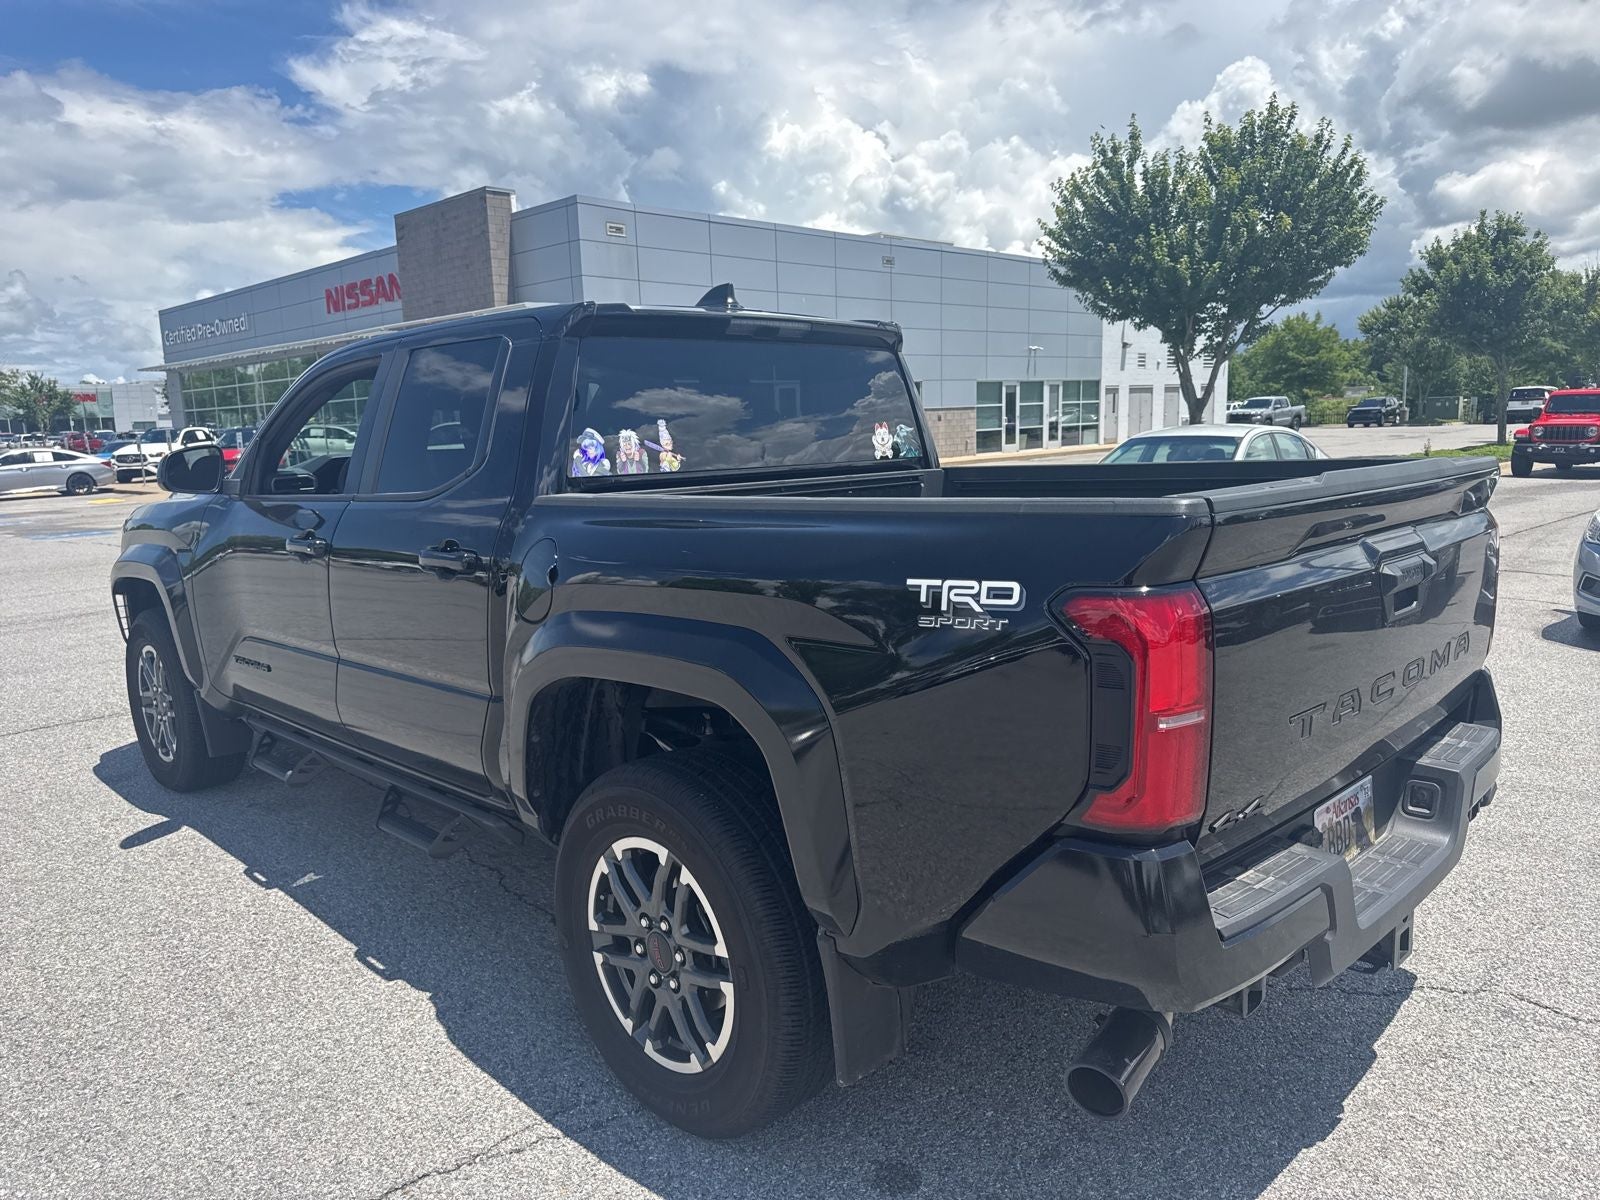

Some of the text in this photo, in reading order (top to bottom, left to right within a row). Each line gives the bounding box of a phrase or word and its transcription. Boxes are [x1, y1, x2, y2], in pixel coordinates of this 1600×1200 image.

[325, 272, 402, 314] NISSAN
[164, 326, 196, 346] Certified
[906, 578, 1022, 613] TRD
[918, 615, 1009, 631] SPORT
[1288, 630, 1471, 741] TACOMA
[586, 804, 666, 832] GRABBER
